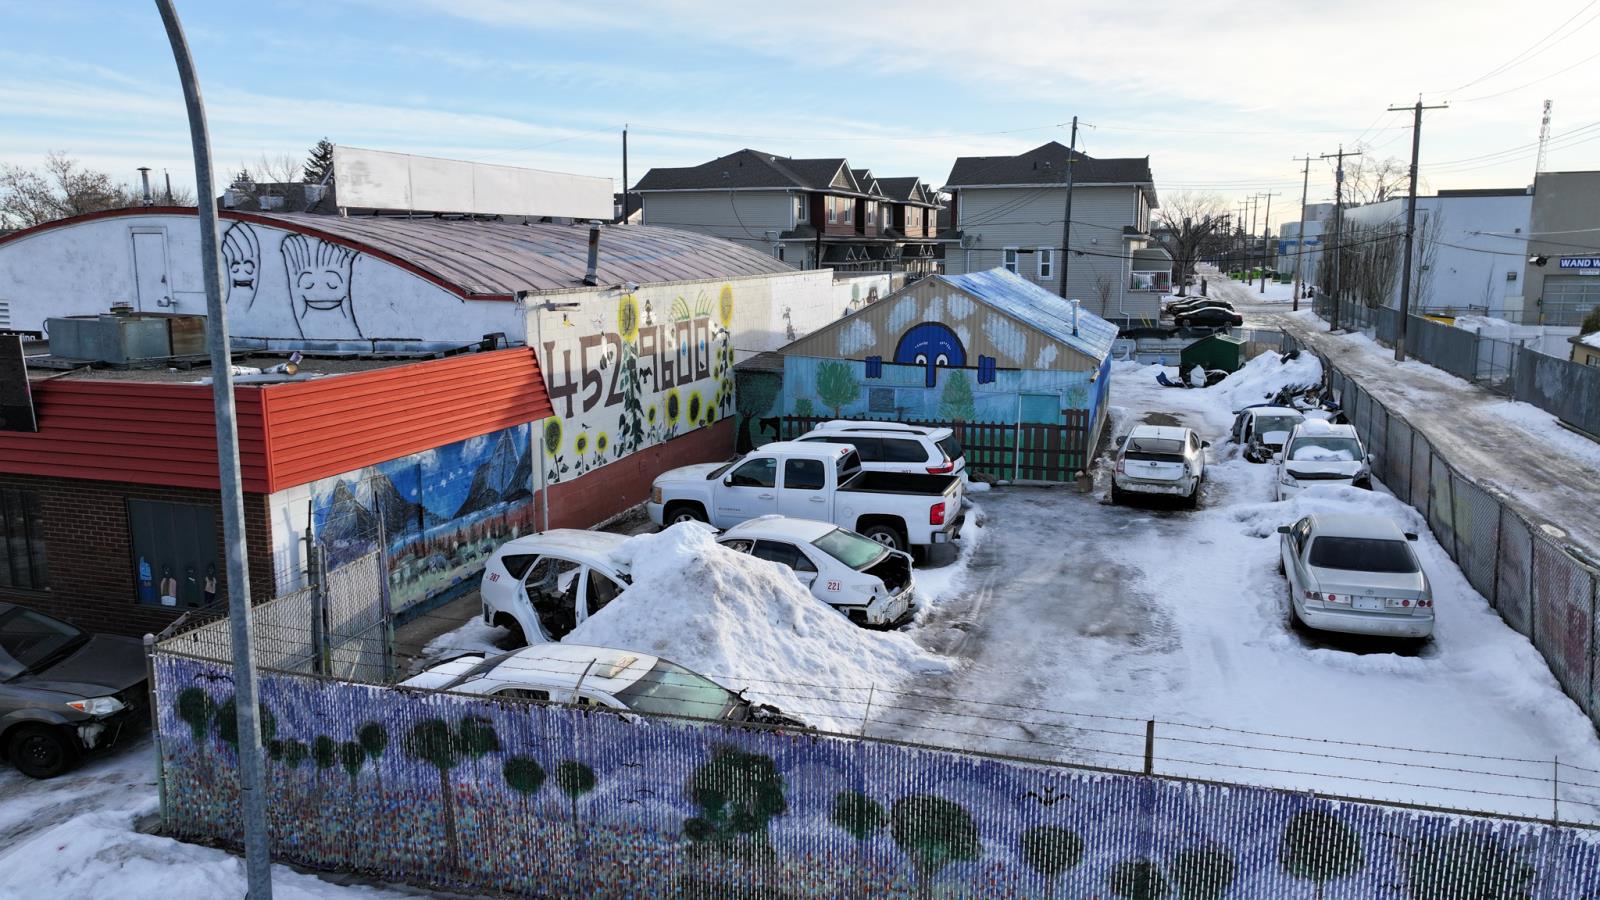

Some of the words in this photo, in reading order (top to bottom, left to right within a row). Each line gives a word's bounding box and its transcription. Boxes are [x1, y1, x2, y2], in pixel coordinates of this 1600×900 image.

[1561, 259, 1591, 267] WAND
[543, 333, 625, 419] 452
[638, 317, 711, 394] 9600
[827, 581, 840, 591] 221
